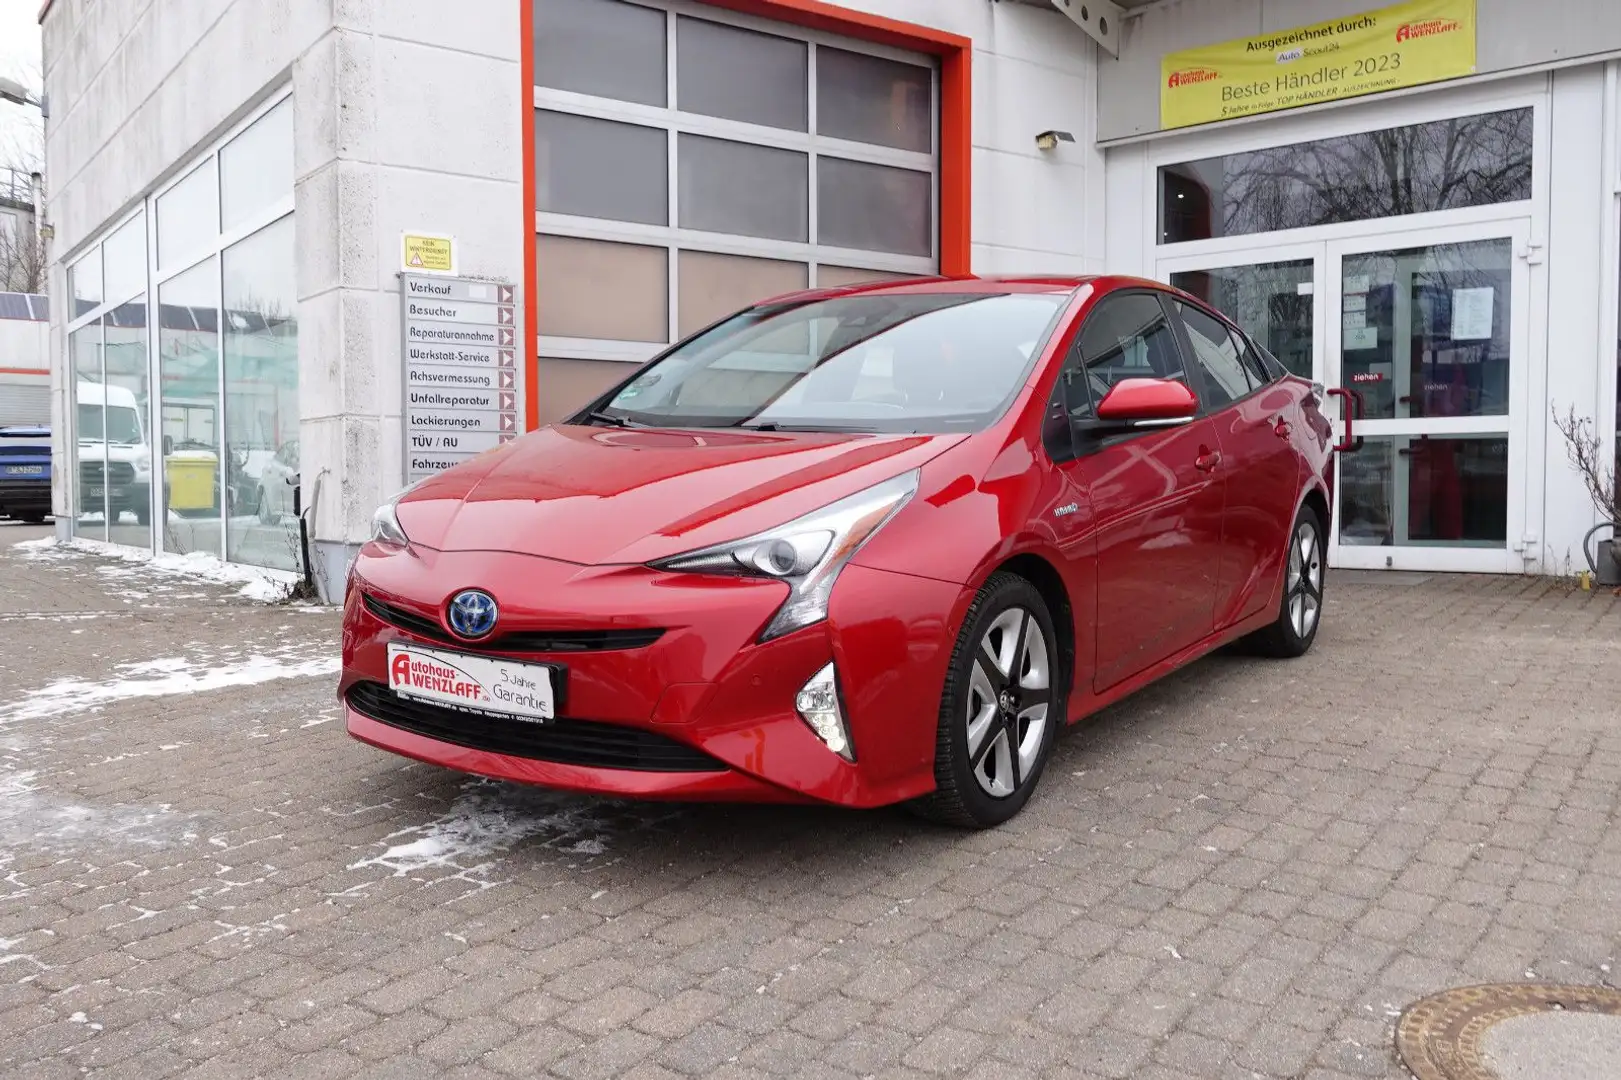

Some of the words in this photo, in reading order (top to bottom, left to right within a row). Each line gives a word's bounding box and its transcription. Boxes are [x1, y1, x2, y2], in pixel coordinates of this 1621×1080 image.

[1246, 26, 1333, 52] Ausgezeichnet
[1336, 17, 1377, 34] durch:
[1278, 52, 1300, 62] Auto
[1303, 43, 1340, 57] Scout24
[1222, 81, 1270, 102] Beste
[1276, 66, 1348, 92] Händler
[1353, 52, 1400, 77] 2023
[1220, 106, 1228, 117] 5
[1277, 94, 1295, 106] TOP
[410, 282, 451, 295] Verkauf
[409, 304, 457, 317] Besucher
[410, 326, 495, 341] Reparaturannahme
[410, 349, 490, 362] Werkstatt-Service
[410, 371, 491, 387] Achsvermessung
[1353, 373, 1379, 381] ziehen
[411, 393, 489, 407] Unfallreparatur
[411, 415, 481, 428] Lackierungen
[412, 434, 433, 447] TÜV
[436, 437, 440, 447] /
[443, 437, 458, 447] AU
[500, 668, 509, 682] 5
[510, 675, 537, 690] Jahre
[493, 684, 547, 712] Garantie
